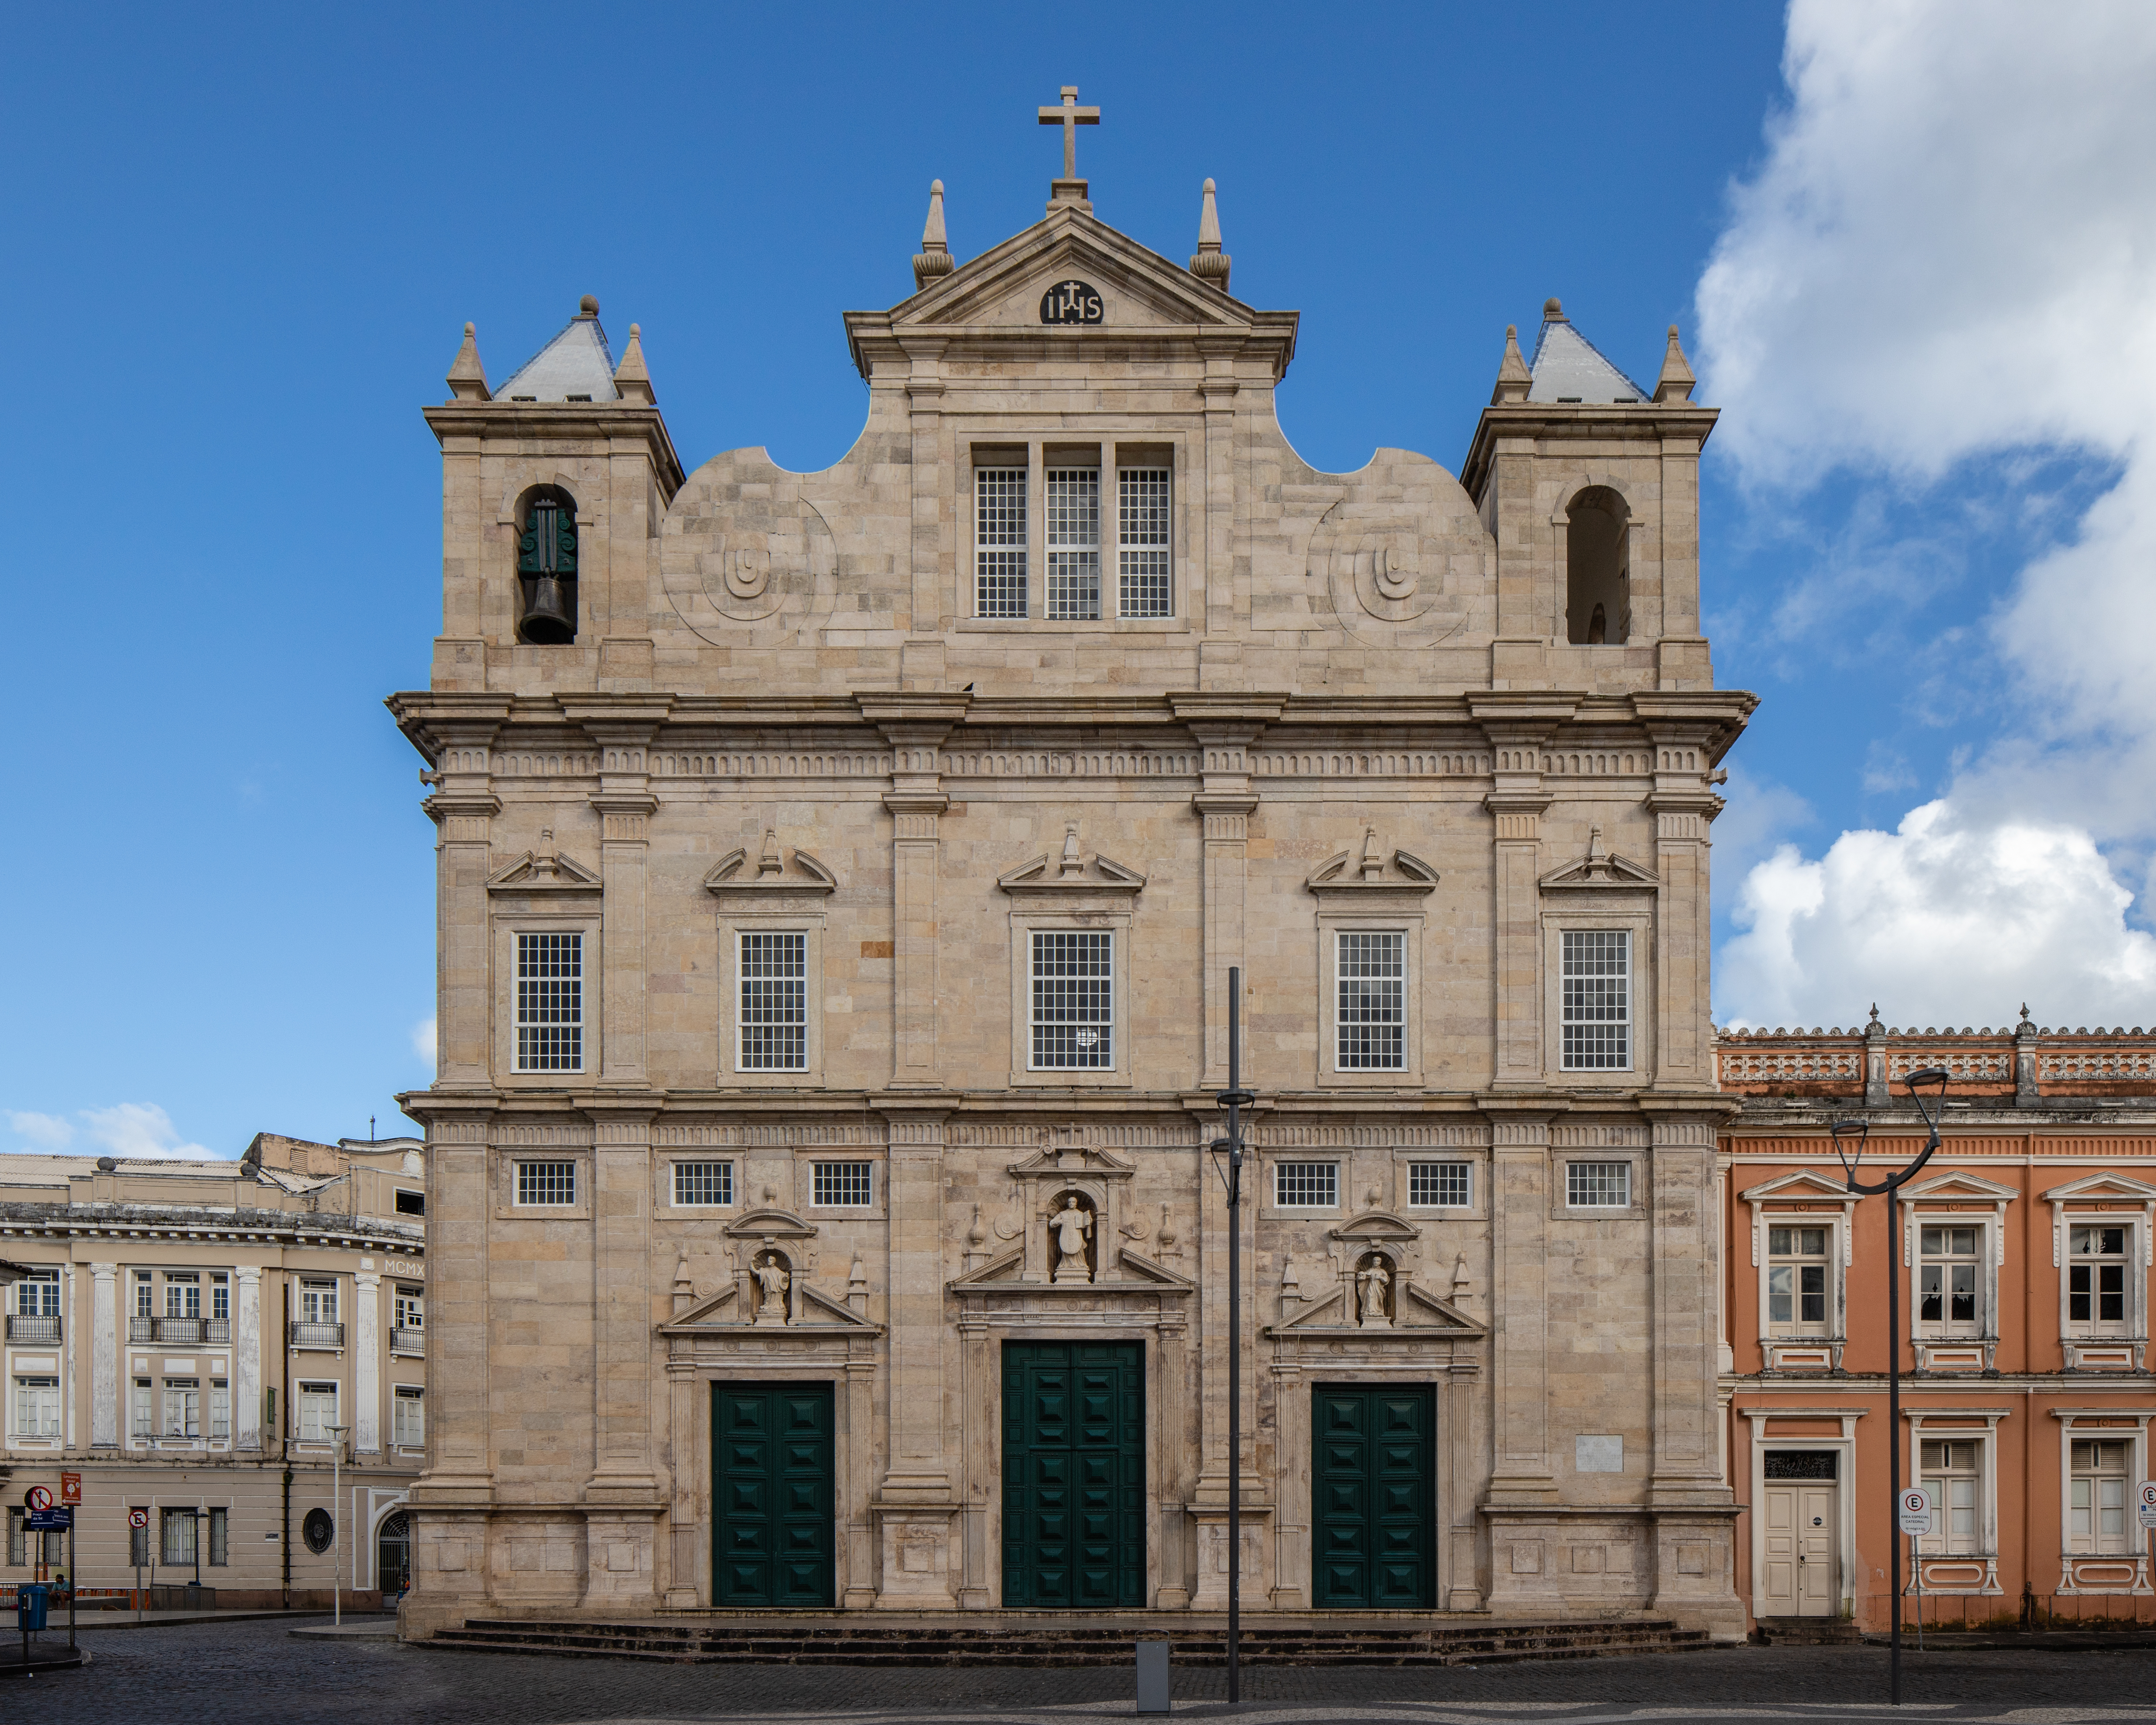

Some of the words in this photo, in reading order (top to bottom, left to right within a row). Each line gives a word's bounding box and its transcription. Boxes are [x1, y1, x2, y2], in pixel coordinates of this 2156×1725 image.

[2148, 1490, 2154, 1500] E
[1911, 1497, 1918, 1507] E
[135, 1514, 142, 1524] E
